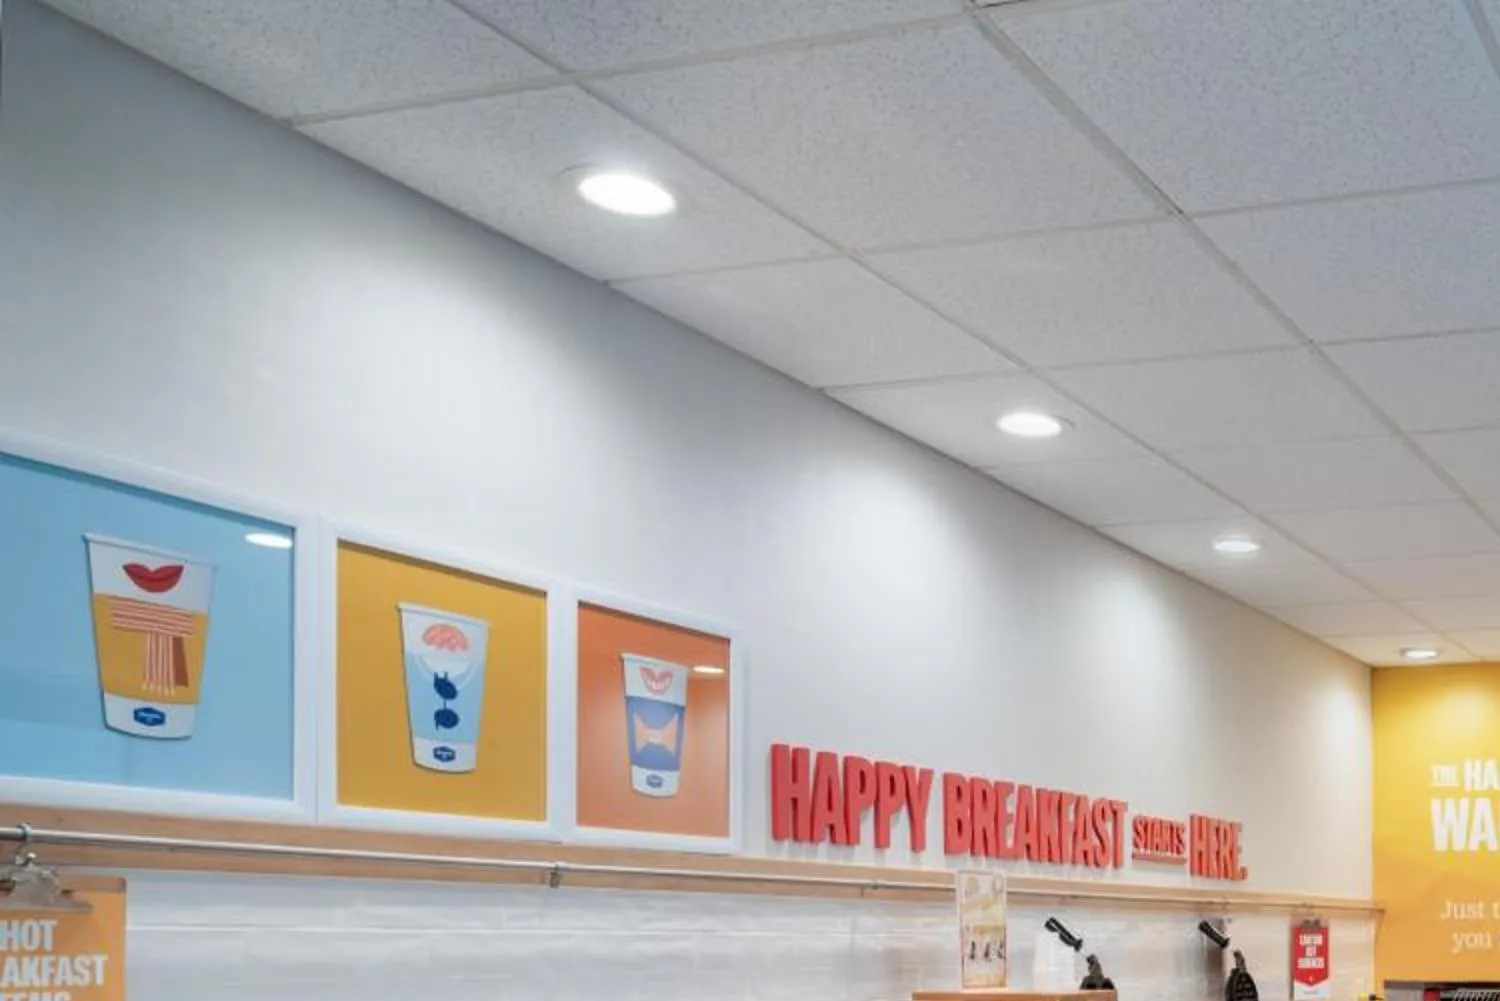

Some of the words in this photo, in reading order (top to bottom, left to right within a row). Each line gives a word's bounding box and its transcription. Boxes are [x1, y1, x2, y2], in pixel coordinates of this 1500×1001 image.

[1431, 765, 1458, 786] THE
[770, 743, 934, 853] HAPPY
[942, 772, 1128, 869] BREAKFAST
[1131, 815, 1185, 855] STARTS
[1440, 899, 1484, 920] Just
[0, 919, 58, 952] HOT
[1451, 931, 1491, 953] you
[0, 955, 108, 987] AKFAST
